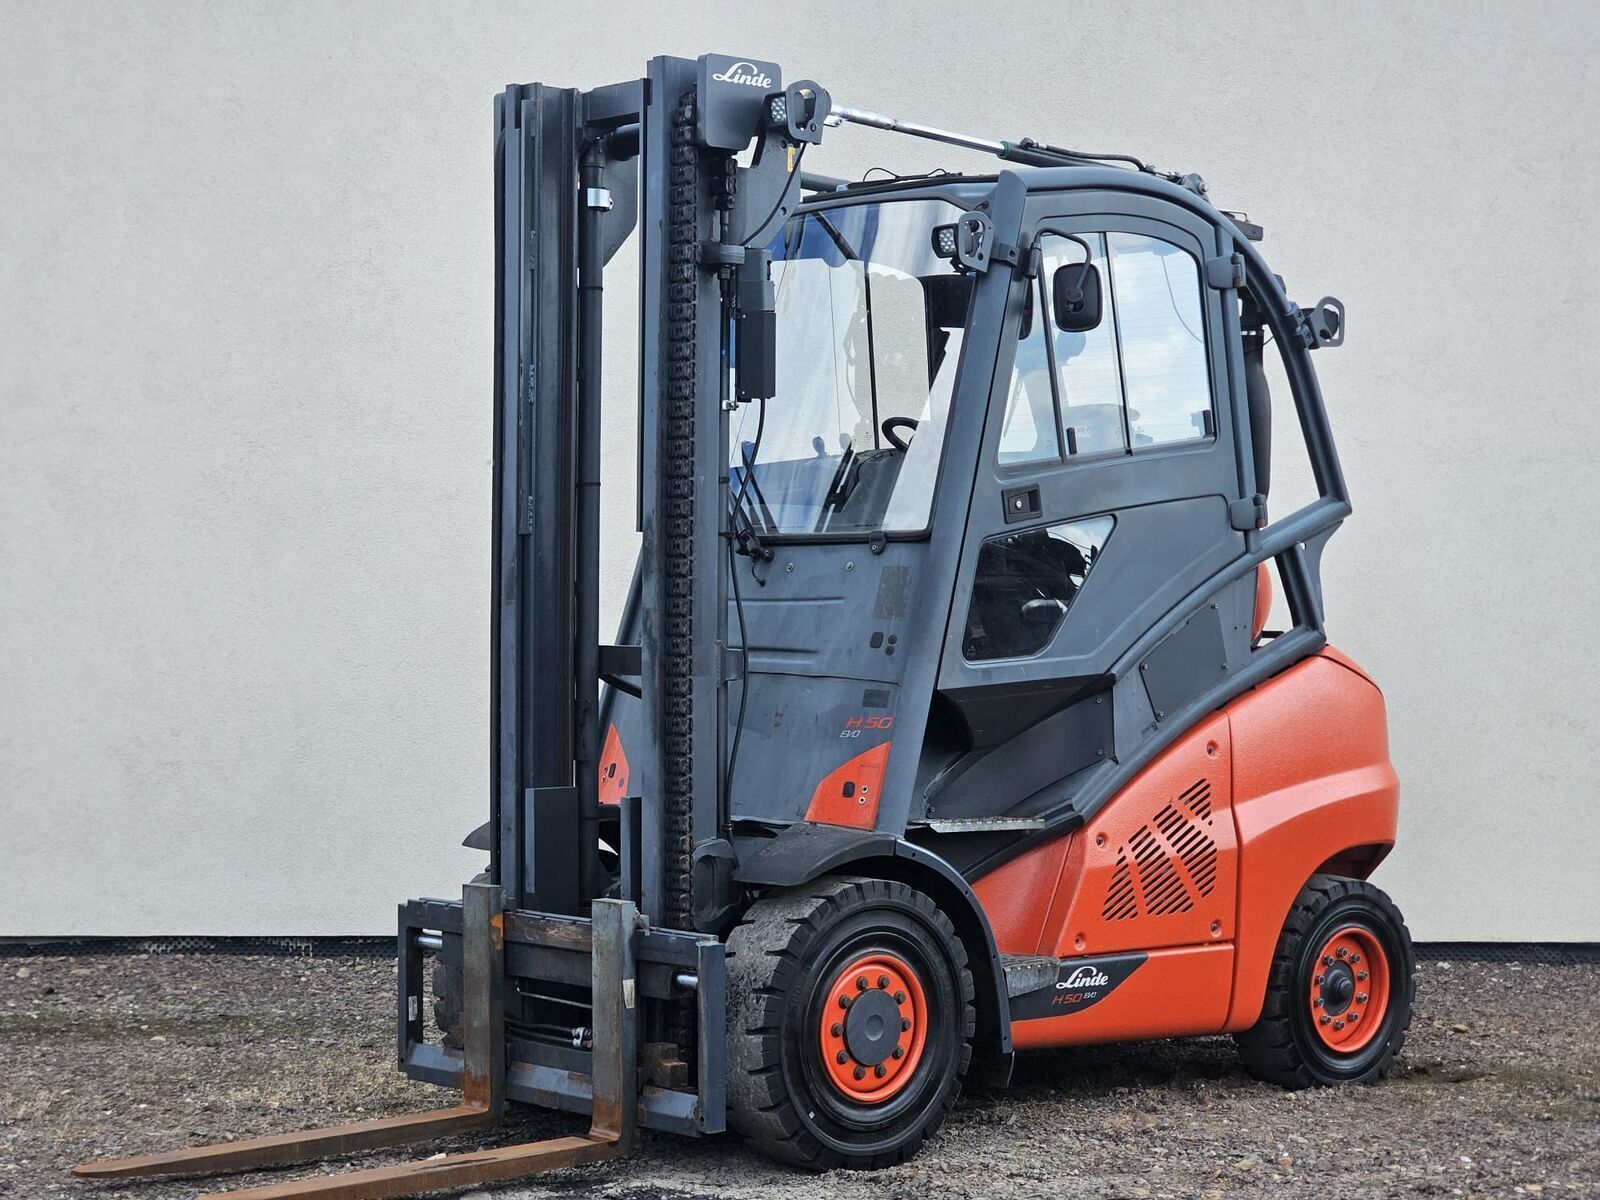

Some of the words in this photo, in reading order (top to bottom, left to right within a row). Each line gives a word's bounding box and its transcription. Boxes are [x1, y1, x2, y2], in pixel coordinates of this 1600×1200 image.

[712, 62, 772, 88] Linde
[839, 729, 861, 738] EVO
[1055, 966, 1109, 989] Linde
